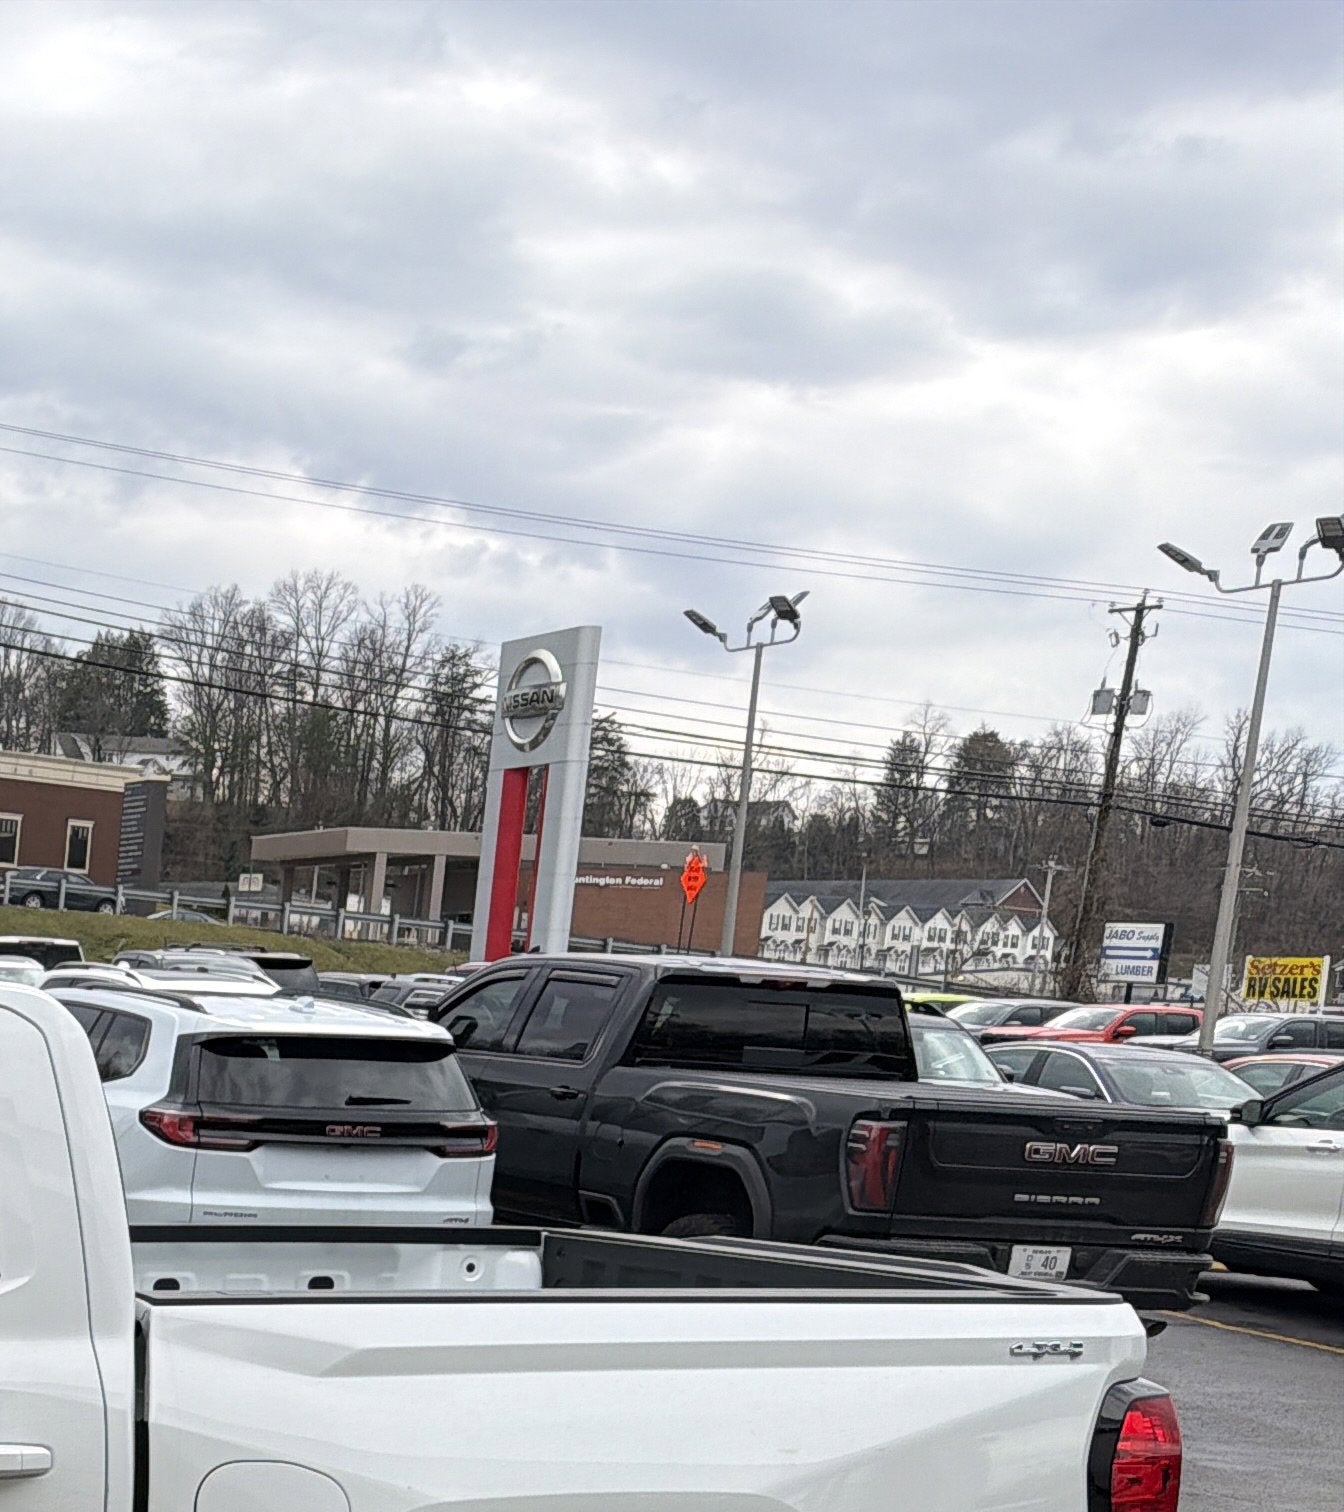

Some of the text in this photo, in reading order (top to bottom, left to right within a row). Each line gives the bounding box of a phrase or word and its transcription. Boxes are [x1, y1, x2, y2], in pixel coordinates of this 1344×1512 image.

[503, 688, 555, 711] NISSAN
[574, 875, 664, 886] untington Federal
[1106, 929, 1136, 941] JABO
[1115, 965, 1154, 977] LUMBER
[1249, 959, 1322, 976] Setzer's
[1246, 977, 1319, 999] RV SALES
[325, 1124, 382, 1138] GMC
[1024, 1141, 1119, 1165] GMC
[1014, 1193, 1101, 1205] SIERRA
[1040, 1255, 1058, 1271] 40
